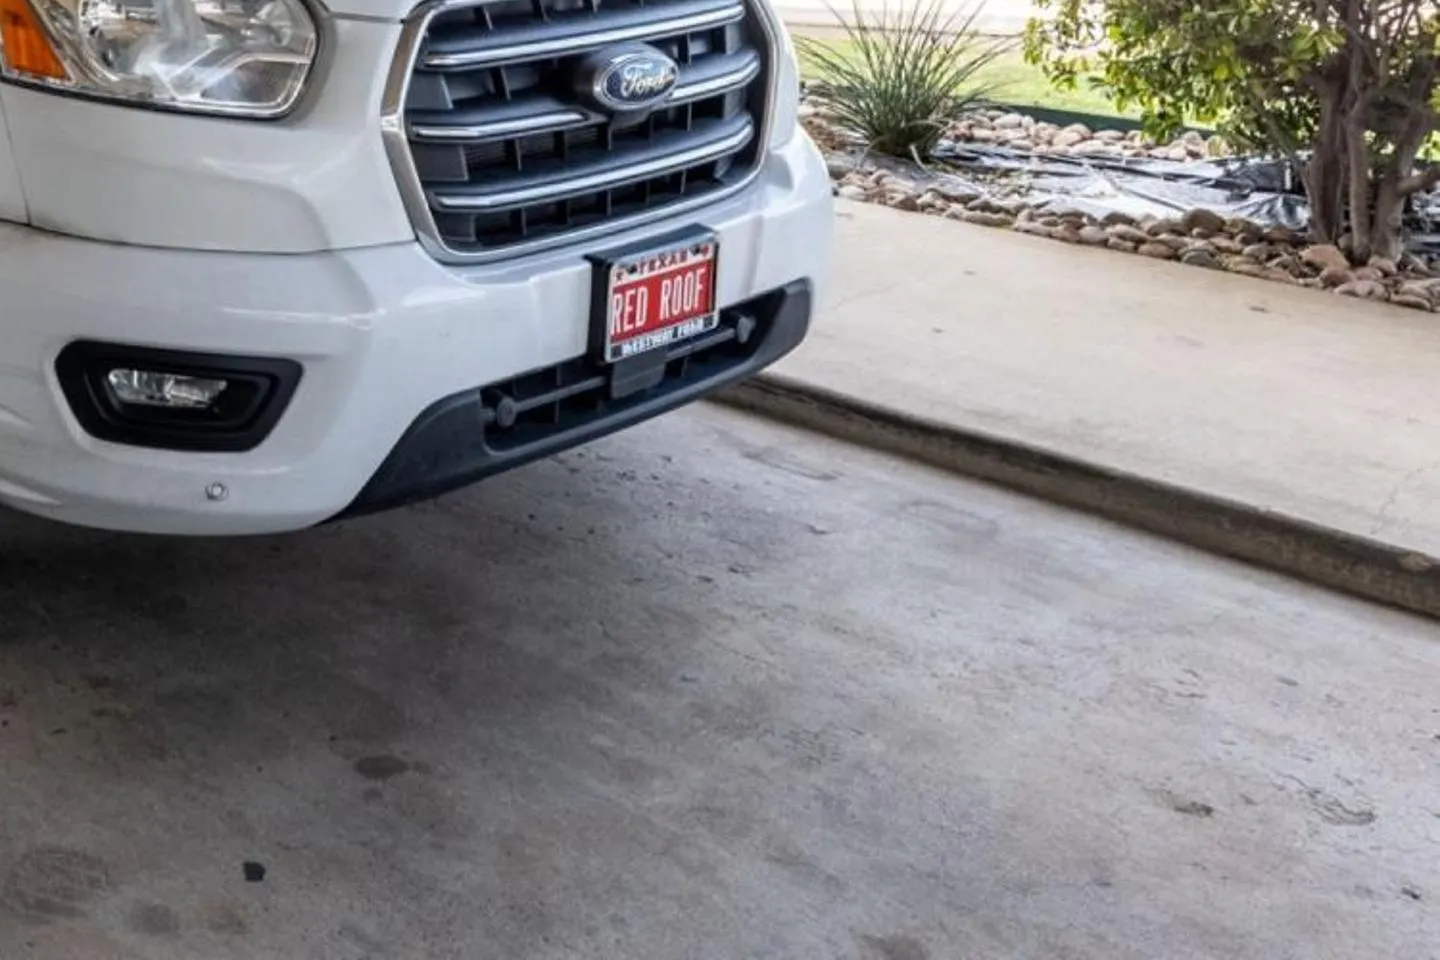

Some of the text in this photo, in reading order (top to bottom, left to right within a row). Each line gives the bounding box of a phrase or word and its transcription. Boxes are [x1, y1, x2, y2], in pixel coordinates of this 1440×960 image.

[620, 61, 676, 98] Ford
[637, 247, 688, 275] TEXAS
[610, 267, 707, 336] RED ROOF
